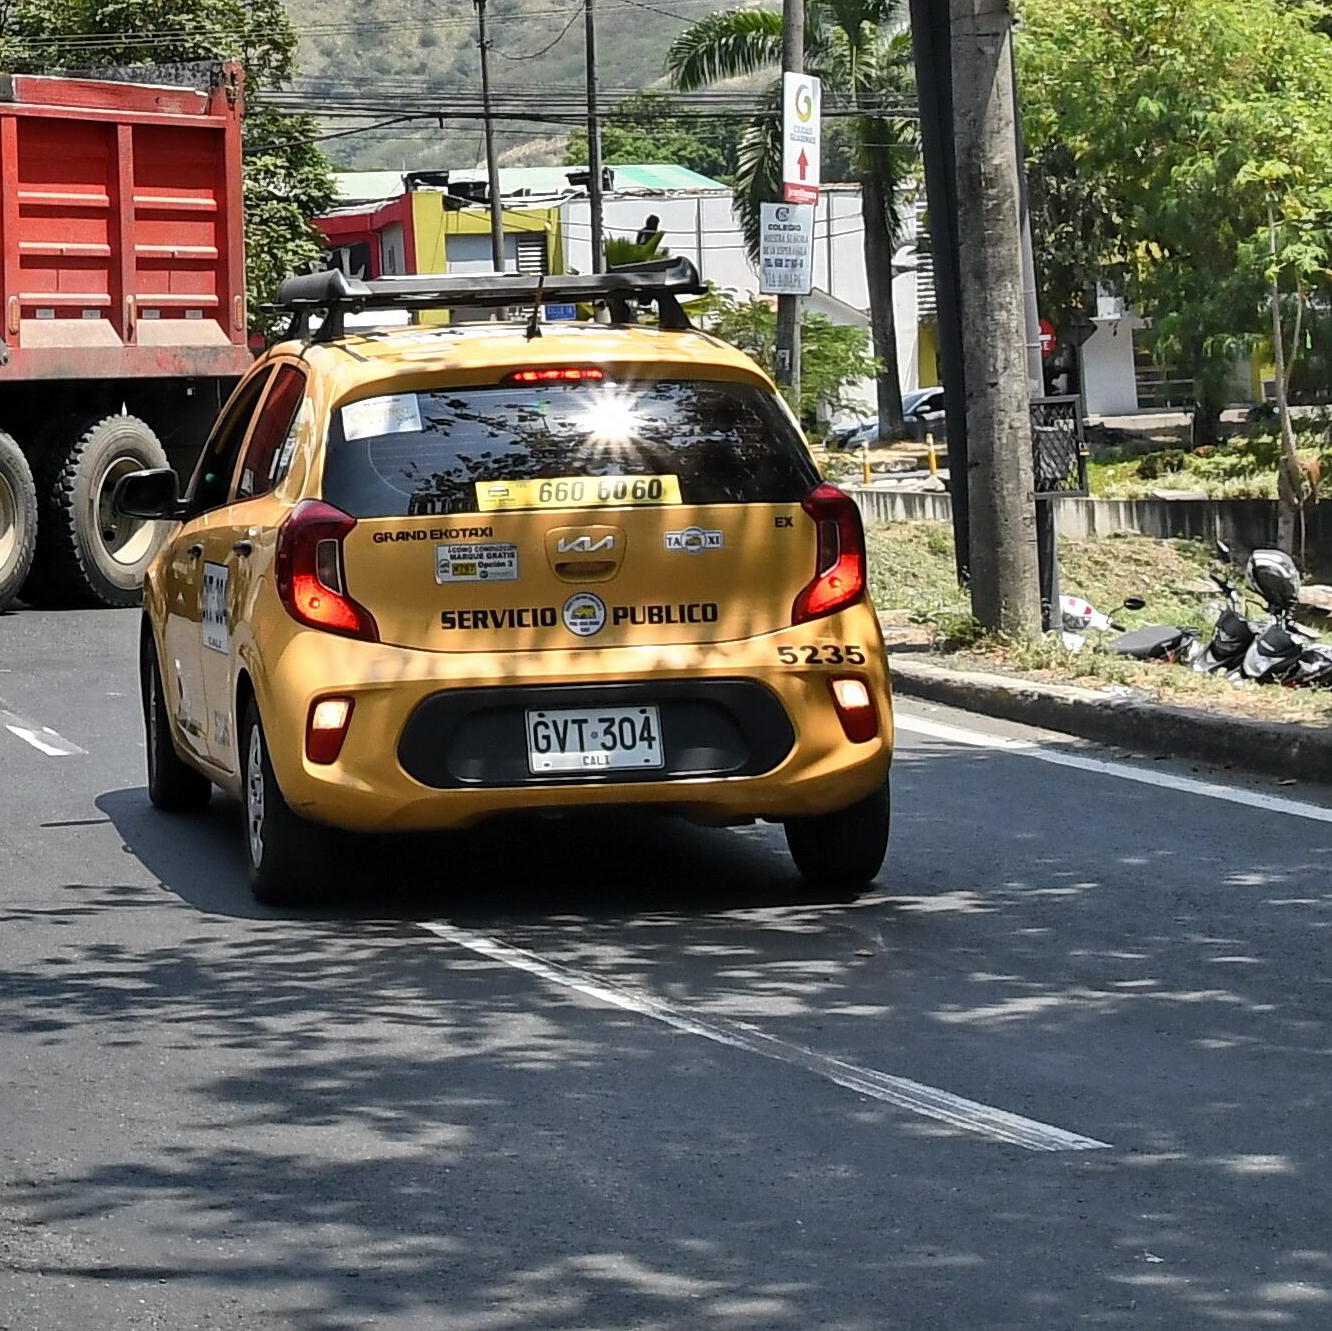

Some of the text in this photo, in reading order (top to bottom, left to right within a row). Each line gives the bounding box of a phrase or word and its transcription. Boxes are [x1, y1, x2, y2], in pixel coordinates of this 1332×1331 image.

[538, 482, 585, 503] 660
[775, 517, 793, 528] EX
[373, 527, 493, 543] GRAND EKOTAXI
[558, 535, 614, 553] KIA
[450, 552, 515, 561] MARQUE GRATIS
[441, 607, 557, 630] SERVICIO
[613, 603, 718, 626] PUBLICO
[777, 645, 866, 665] 5235
[533, 717, 656, 754] GVT 304
[583, 755, 610, 766] CALI
